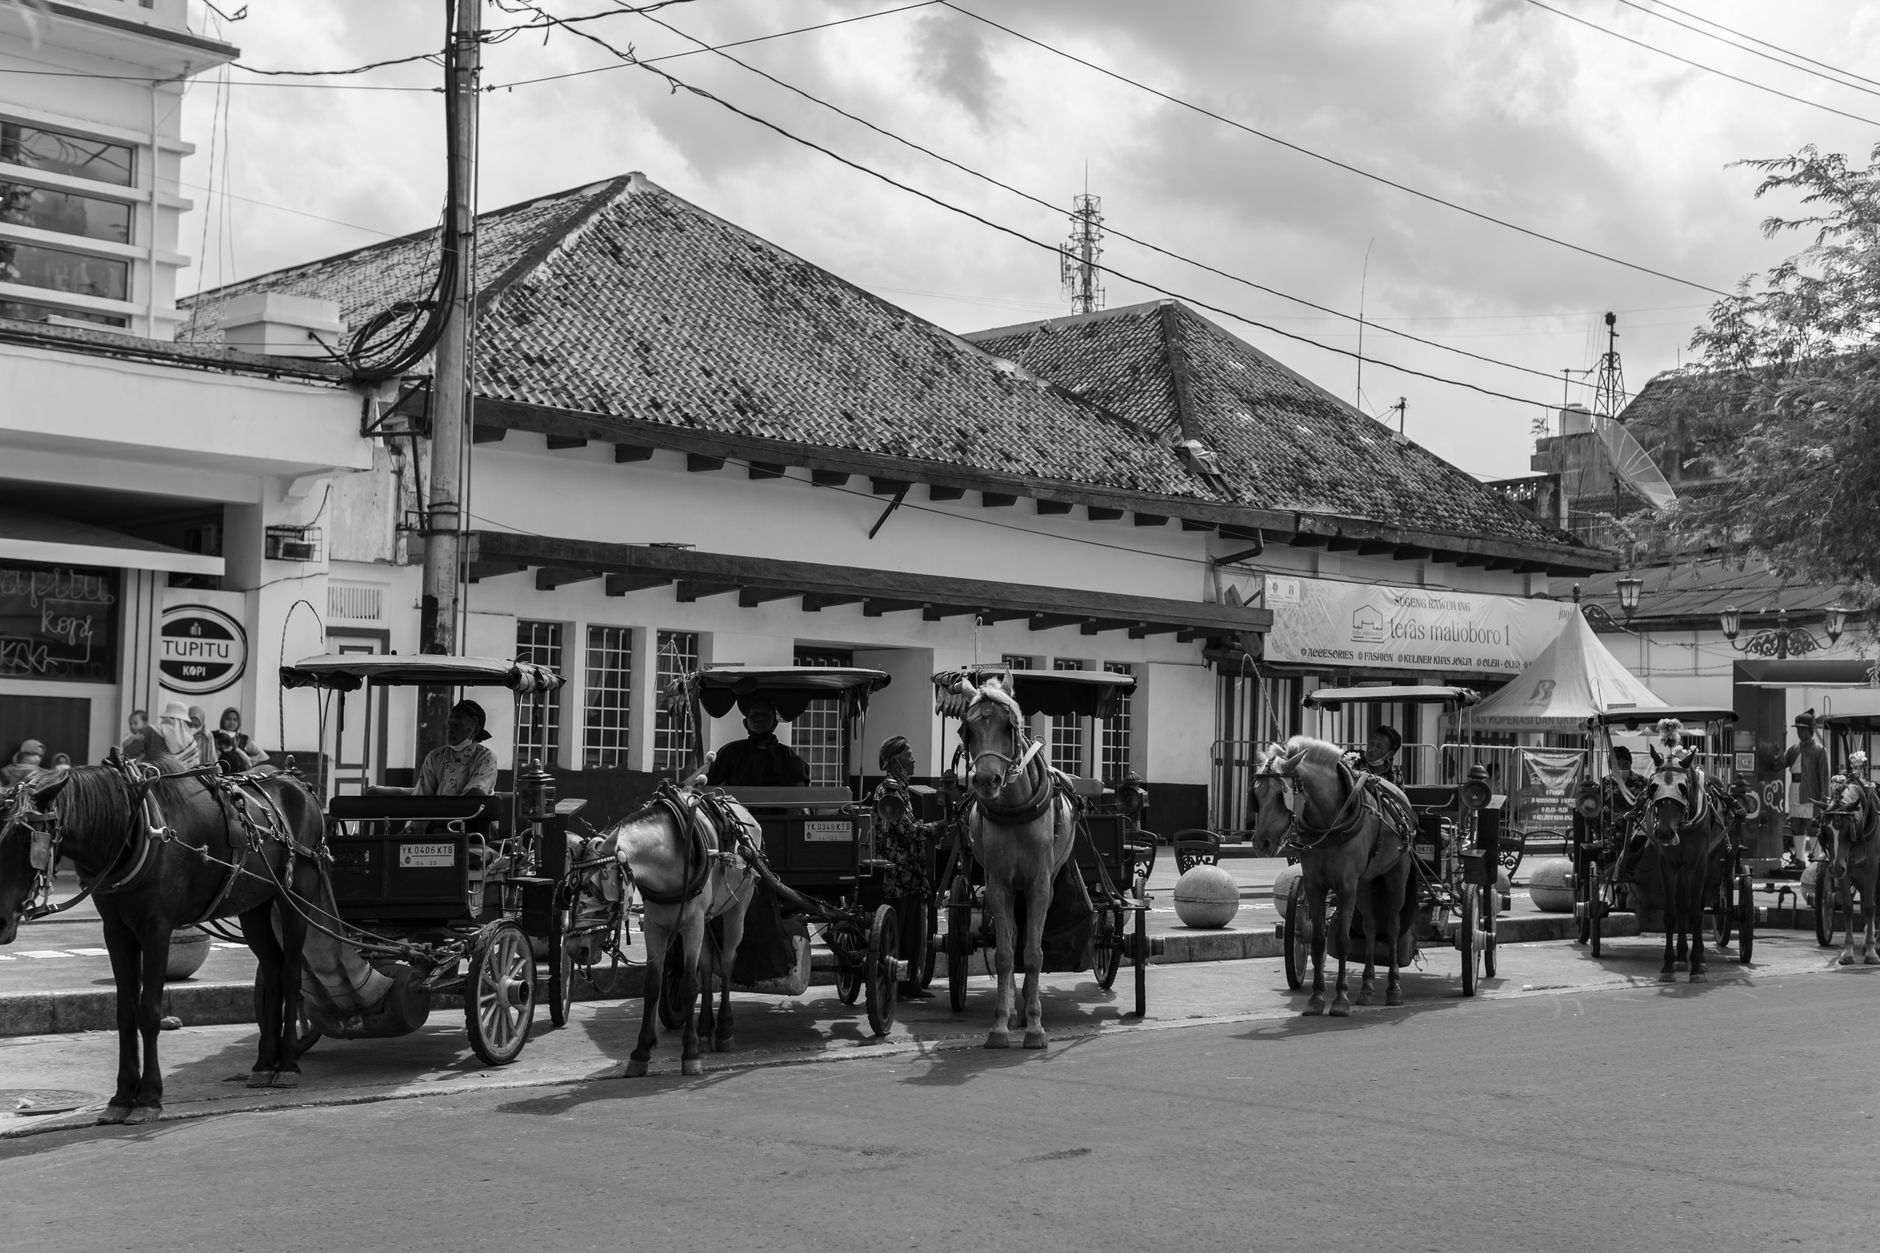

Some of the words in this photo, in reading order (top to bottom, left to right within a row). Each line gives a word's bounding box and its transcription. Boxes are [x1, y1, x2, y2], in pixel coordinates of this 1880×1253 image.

[1394, 596, 1427, 609] SUGENG
[1457, 601, 1471, 612] ING
[1390, 617, 1425, 641] teras
[1430, 621, 1500, 644] malioboro
[1504, 624, 1510, 646] 1
[162, 640, 229, 658] TUPITU
[1307, 647, 1354, 660] ACCESORIES
[1364, 651, 1394, 663] FASHION
[1403, 655, 1432, 665] KULINER
[1433, 656, 1451, 666] KHAS
[1451, 656, 1473, 667] JOGJA
[1483, 658, 1500, 668] OLEH
[182, 664, 206, 677] KOPI
[1489, 716, 1533, 726] KOPERASI
[1535, 716, 1554, 726] DAN
[1557, 716, 1577, 726] UKM
[806, 823, 816, 831] YK
[402, 845, 413, 854] YK
[414, 845, 436, 854] 0406
